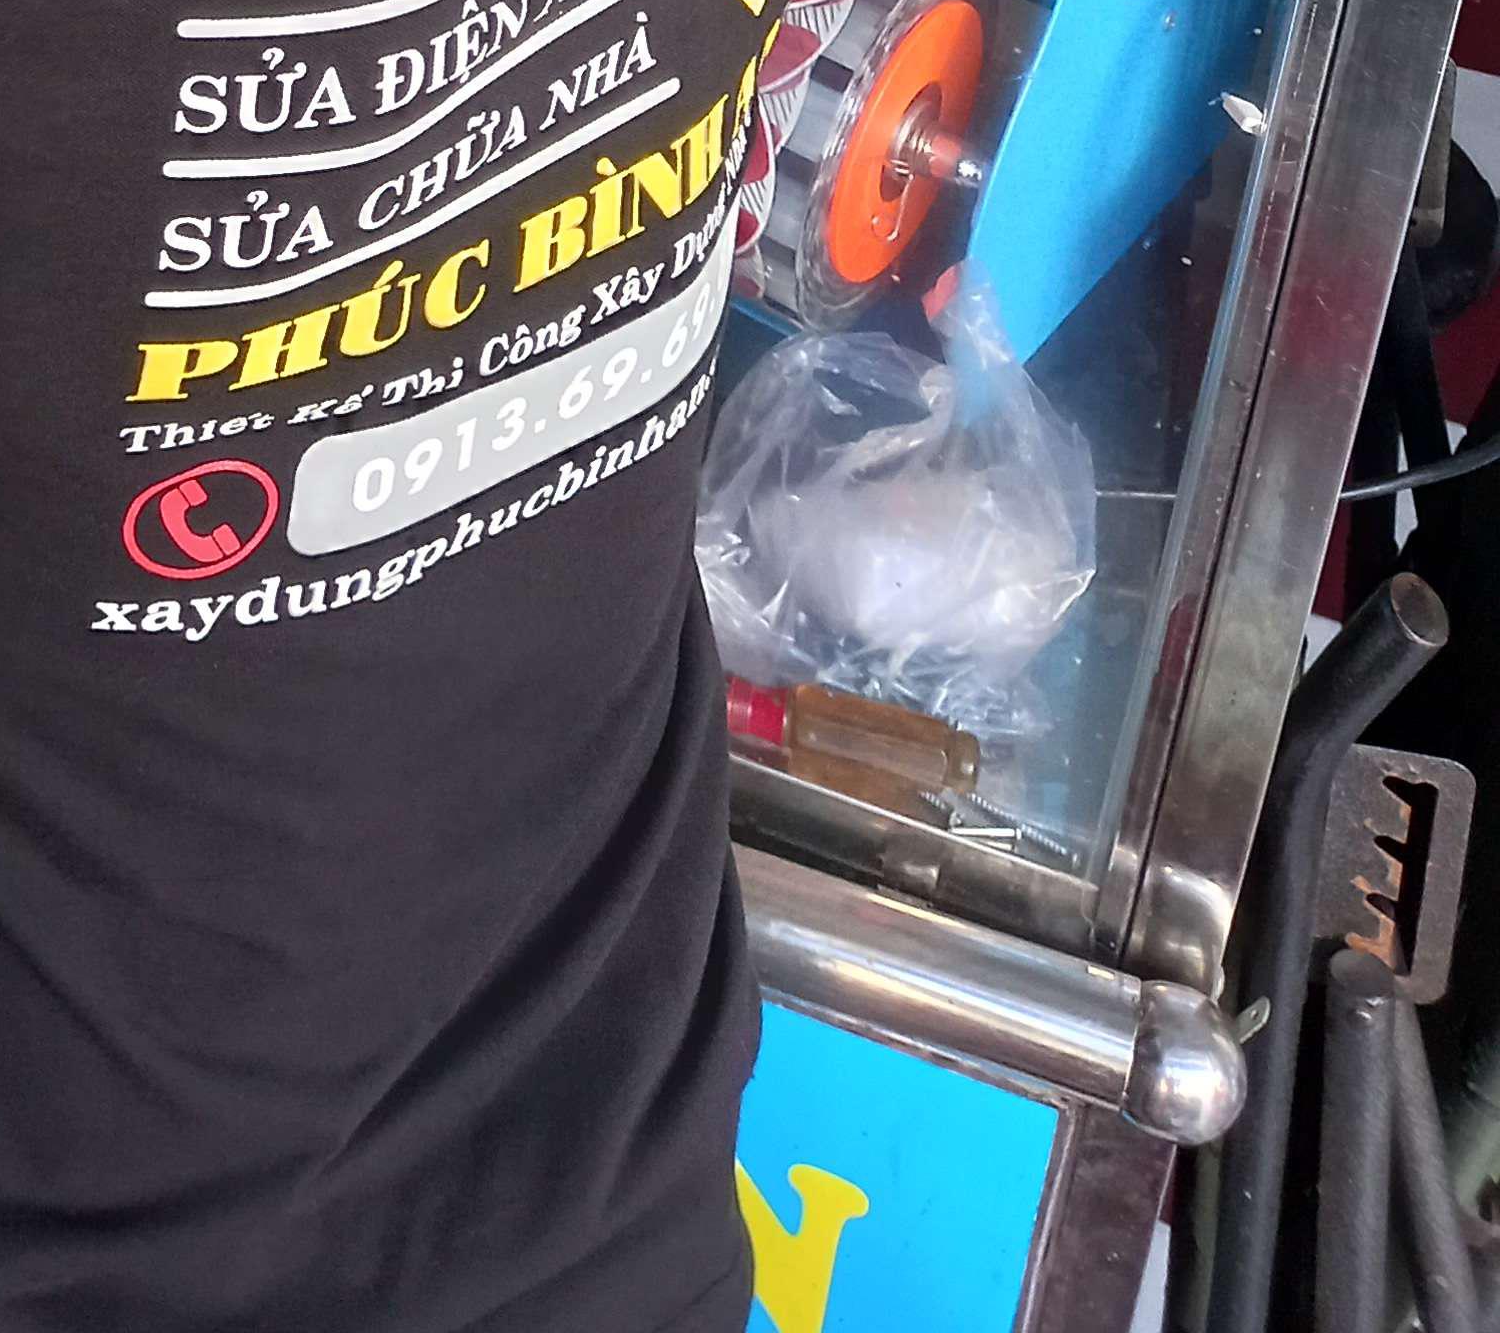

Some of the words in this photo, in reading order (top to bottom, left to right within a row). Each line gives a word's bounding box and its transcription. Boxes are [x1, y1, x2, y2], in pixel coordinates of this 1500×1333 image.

[159, 190, 334, 272] SỬA
[358, 105, 528, 231] CHỮA
[539, 11, 657, 131] NHÀ
[174, 47, 357, 134] SỬA
[125, 238, 490, 402] PHÚC
[512, 93, 729, 294] BÌNH
[382, 356, 465, 406] Thi
[479, 304, 587, 377] Công
[590, 262, 665, 325] Xây
